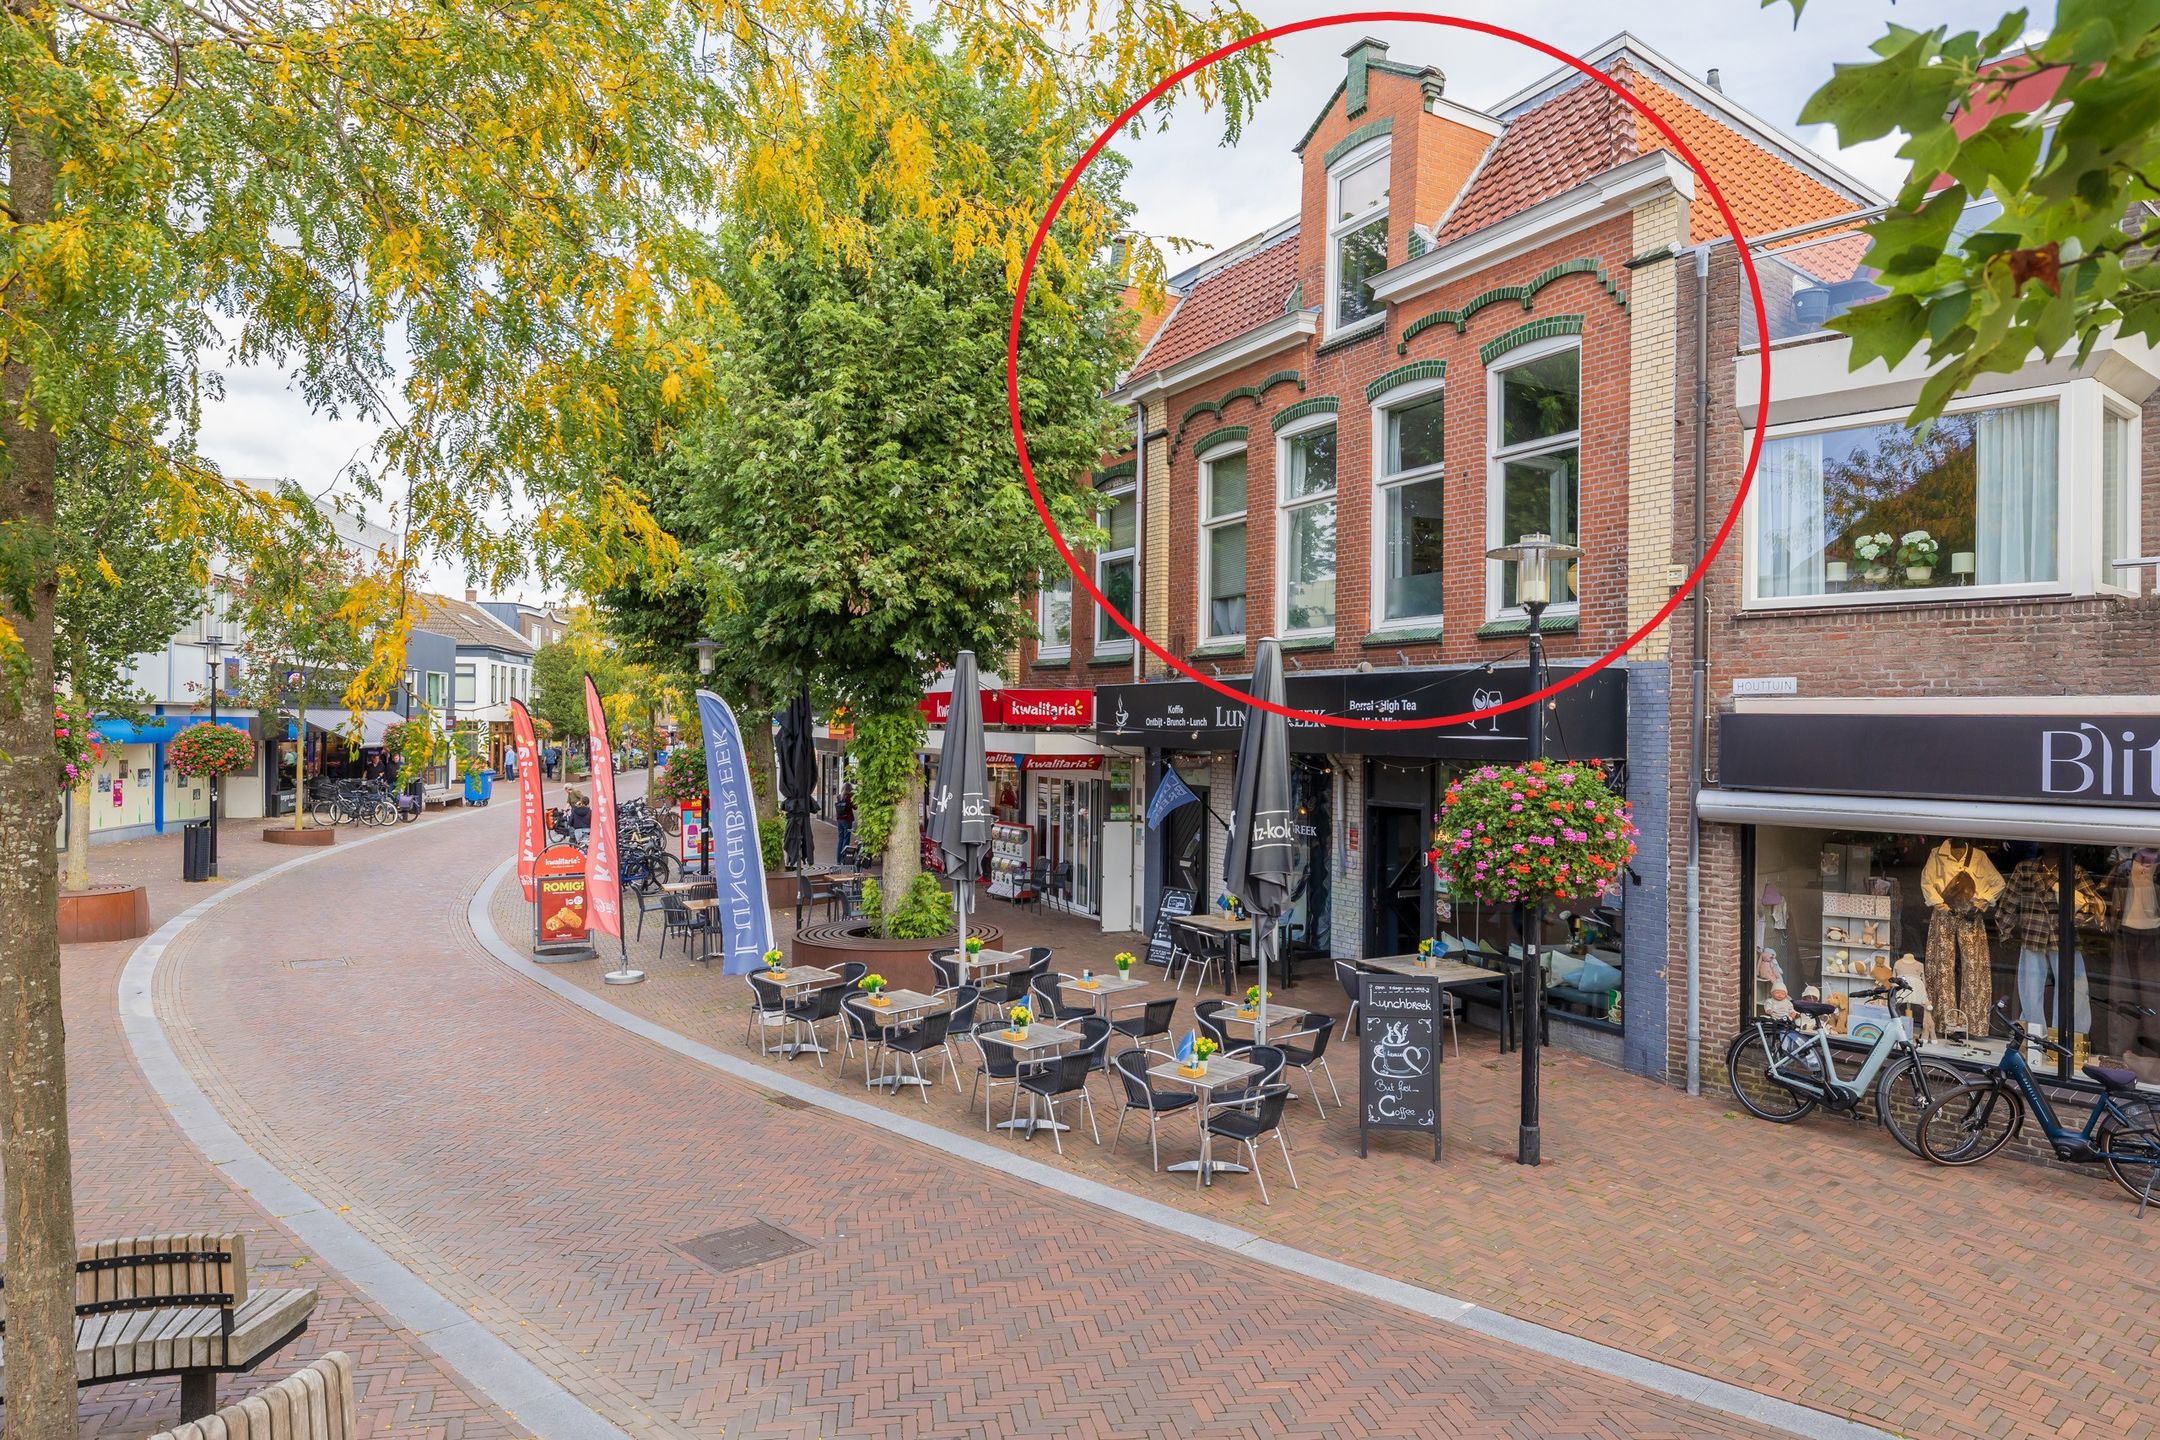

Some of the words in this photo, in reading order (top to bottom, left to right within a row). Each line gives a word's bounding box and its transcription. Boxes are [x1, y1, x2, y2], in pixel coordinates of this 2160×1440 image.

[1737, 681, 1792, 691] HOUTTUIN
[1012, 701, 1076, 717] kwalitaria
[1167, 705, 1184, 714] Koffie
[1349, 700, 1374, 711] Borrel
[1401, 700, 1417, 711] Tea
[1145, 718, 1163, 728] Ontbijt
[1166, 717, 1186, 727] Brunch
[1189, 717, 1208, 727] Lunch
[1026, 759, 1088, 769] kwalitaria
[543, 881, 585, 892] ROMIG!
[1374, 1079, 1394, 1092] But
[1379, 1094, 1417, 1120] Coffee
